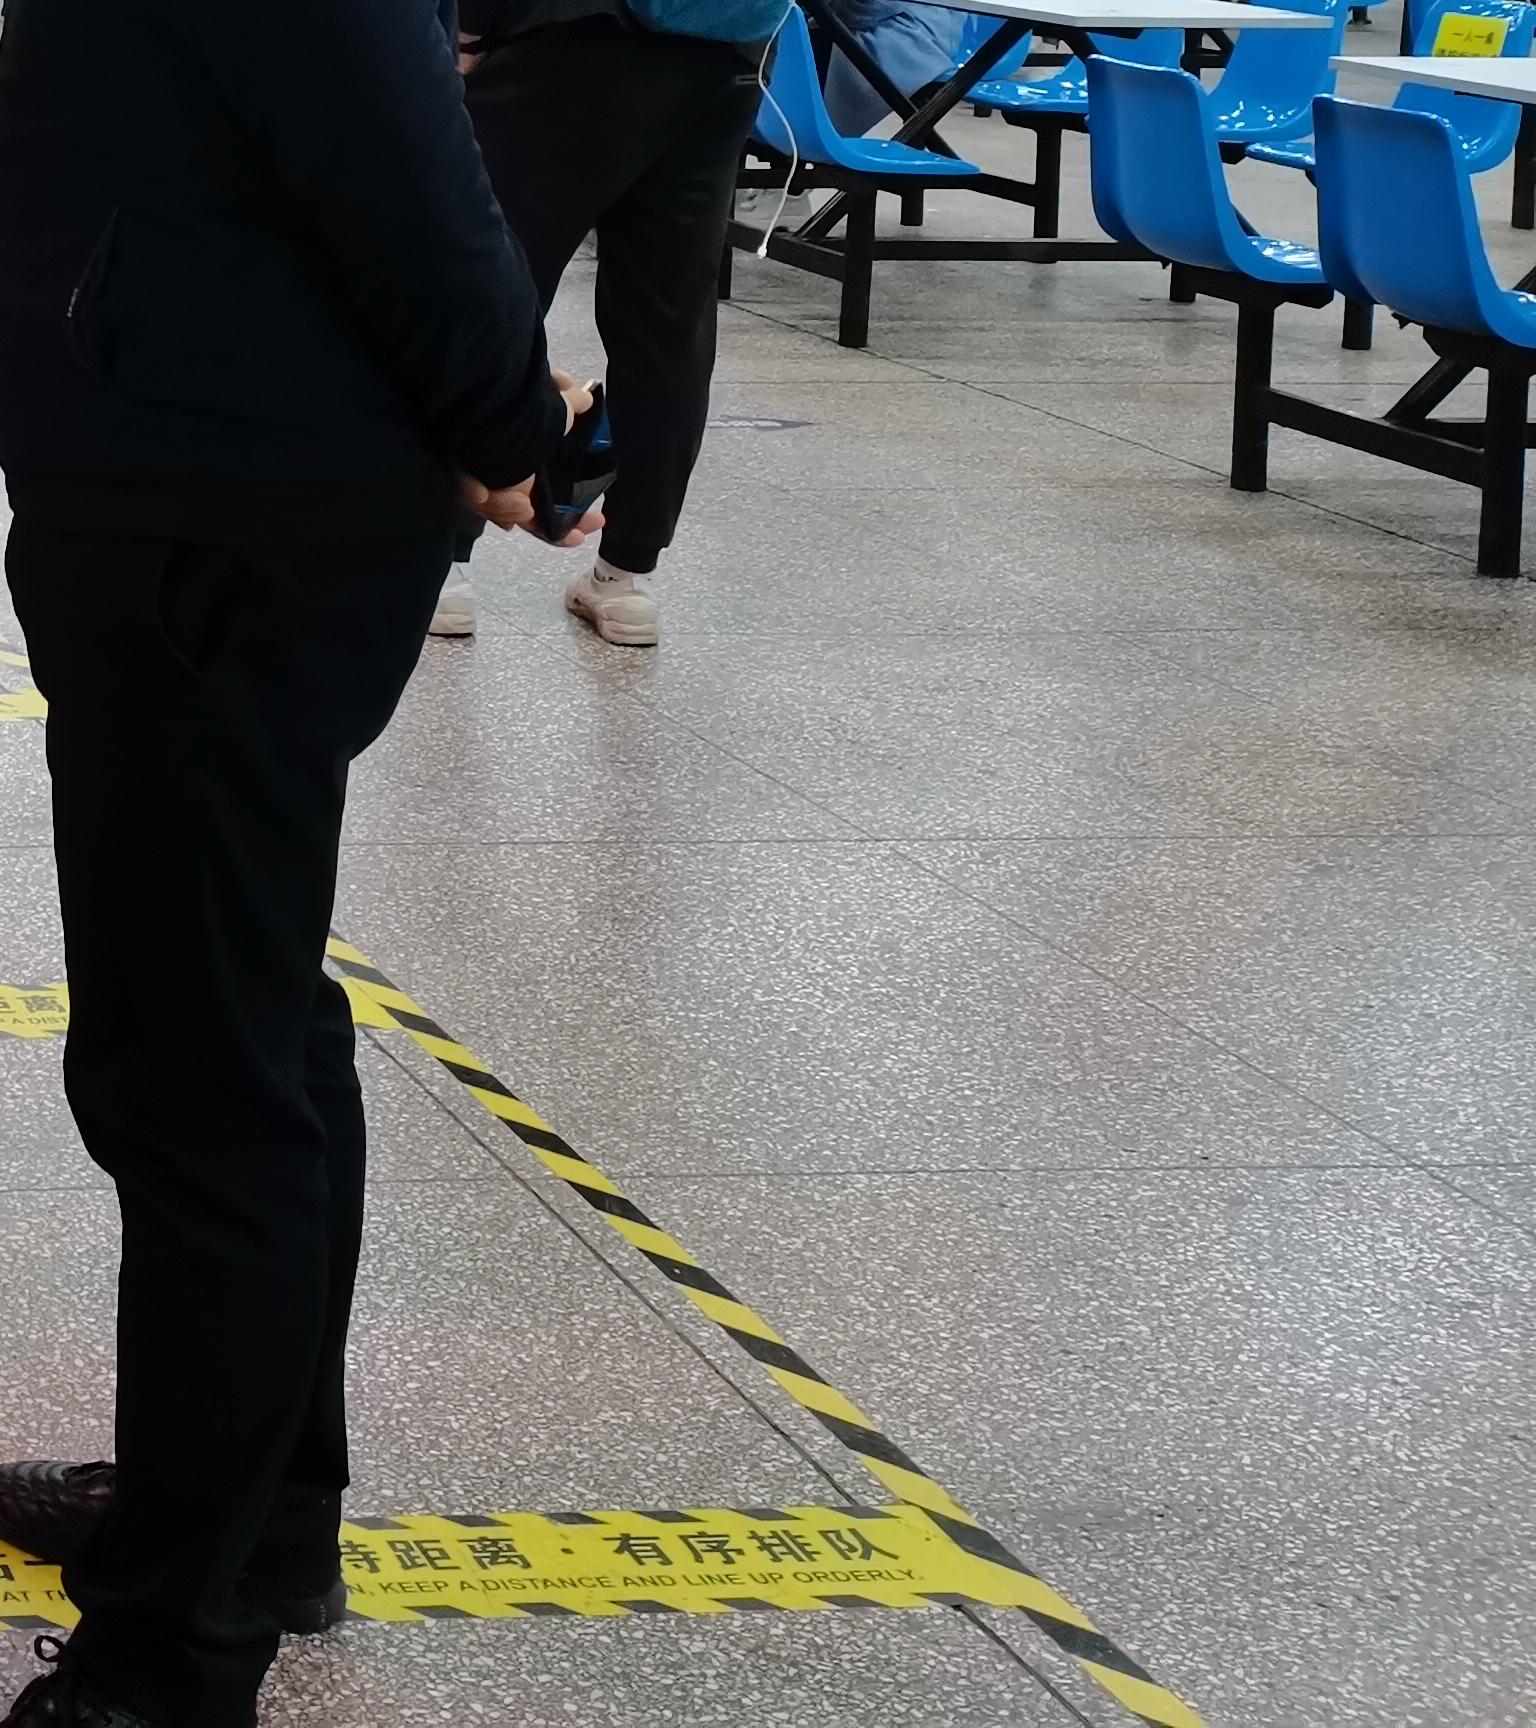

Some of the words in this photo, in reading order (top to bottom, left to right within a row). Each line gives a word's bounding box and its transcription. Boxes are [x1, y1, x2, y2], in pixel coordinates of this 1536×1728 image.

[2, 1590, 31, 1603] AT
[43, 1590, 69, 1602] TH
[380, 1580, 449, 1594] KEEP
[459, 1579, 478, 1592] A
[482, 1575, 617, 1592] DISTANCE
[623, 1573, 678, 1588] AND
[685, 1572, 746, 1586] LINE
[752, 1571, 785, 1585] UP
[791, 1568, 927, 1584] ORDERLY.
